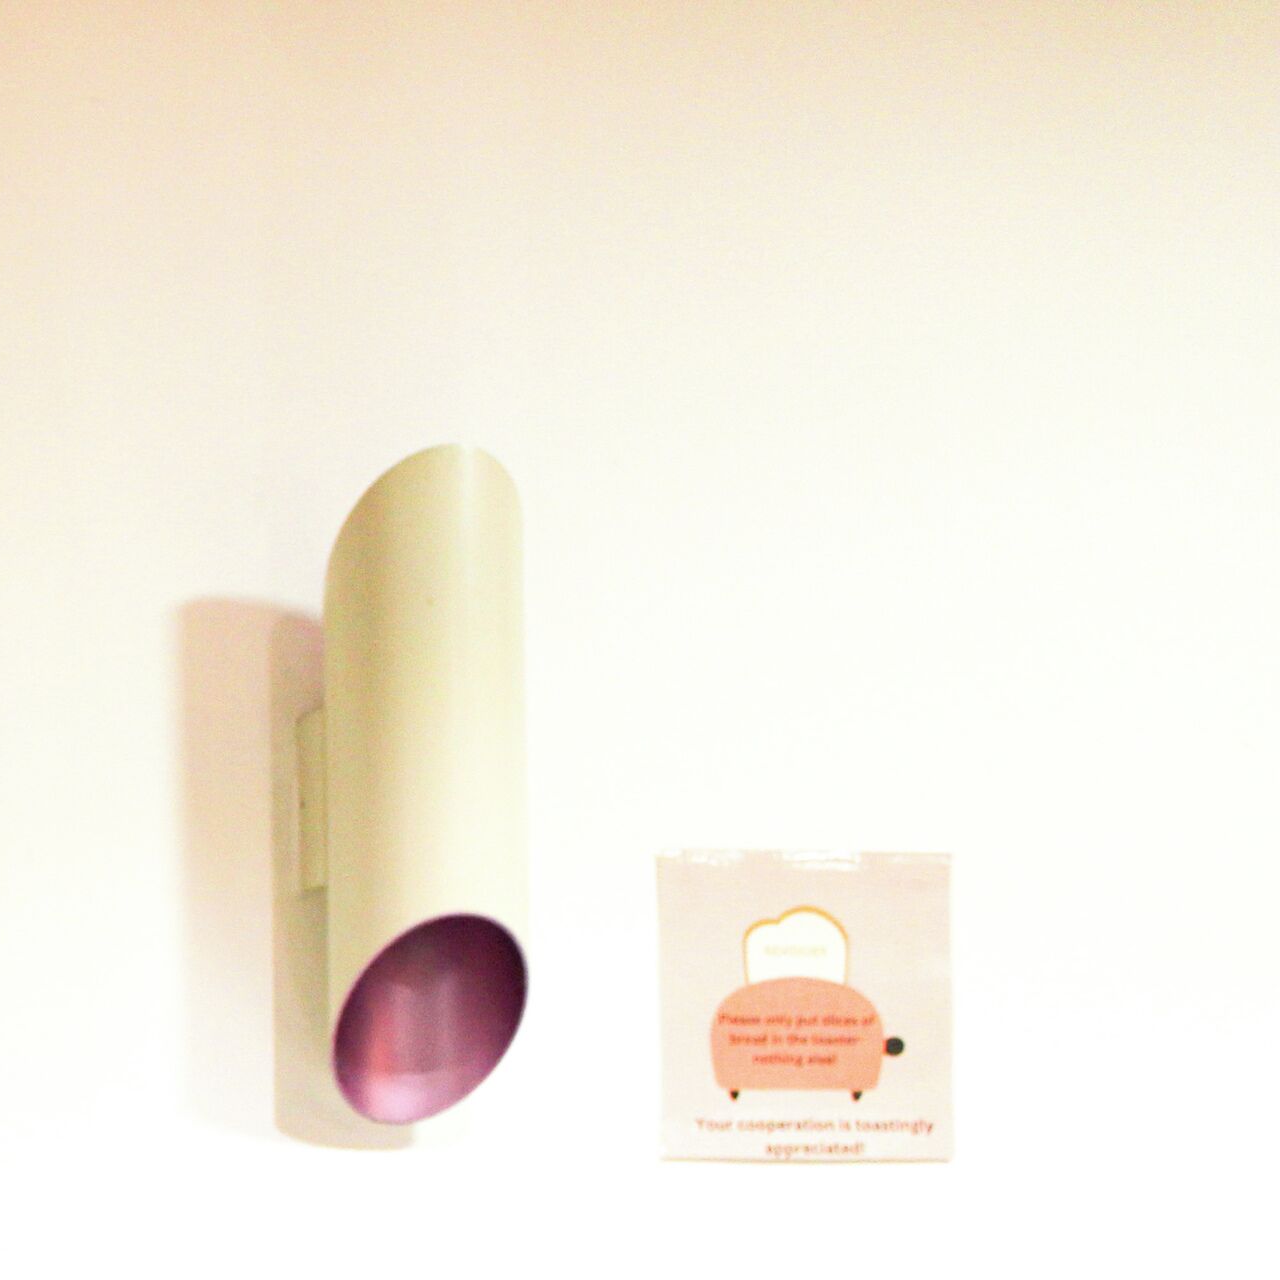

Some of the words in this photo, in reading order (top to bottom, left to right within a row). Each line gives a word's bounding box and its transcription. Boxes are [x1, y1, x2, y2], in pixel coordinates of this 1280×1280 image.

[696, 1118, 733, 1132] Your
[736, 1118, 835, 1134] cooperation
[838, 1118, 852, 1131] is
[855, 1117, 934, 1134] toastingly
